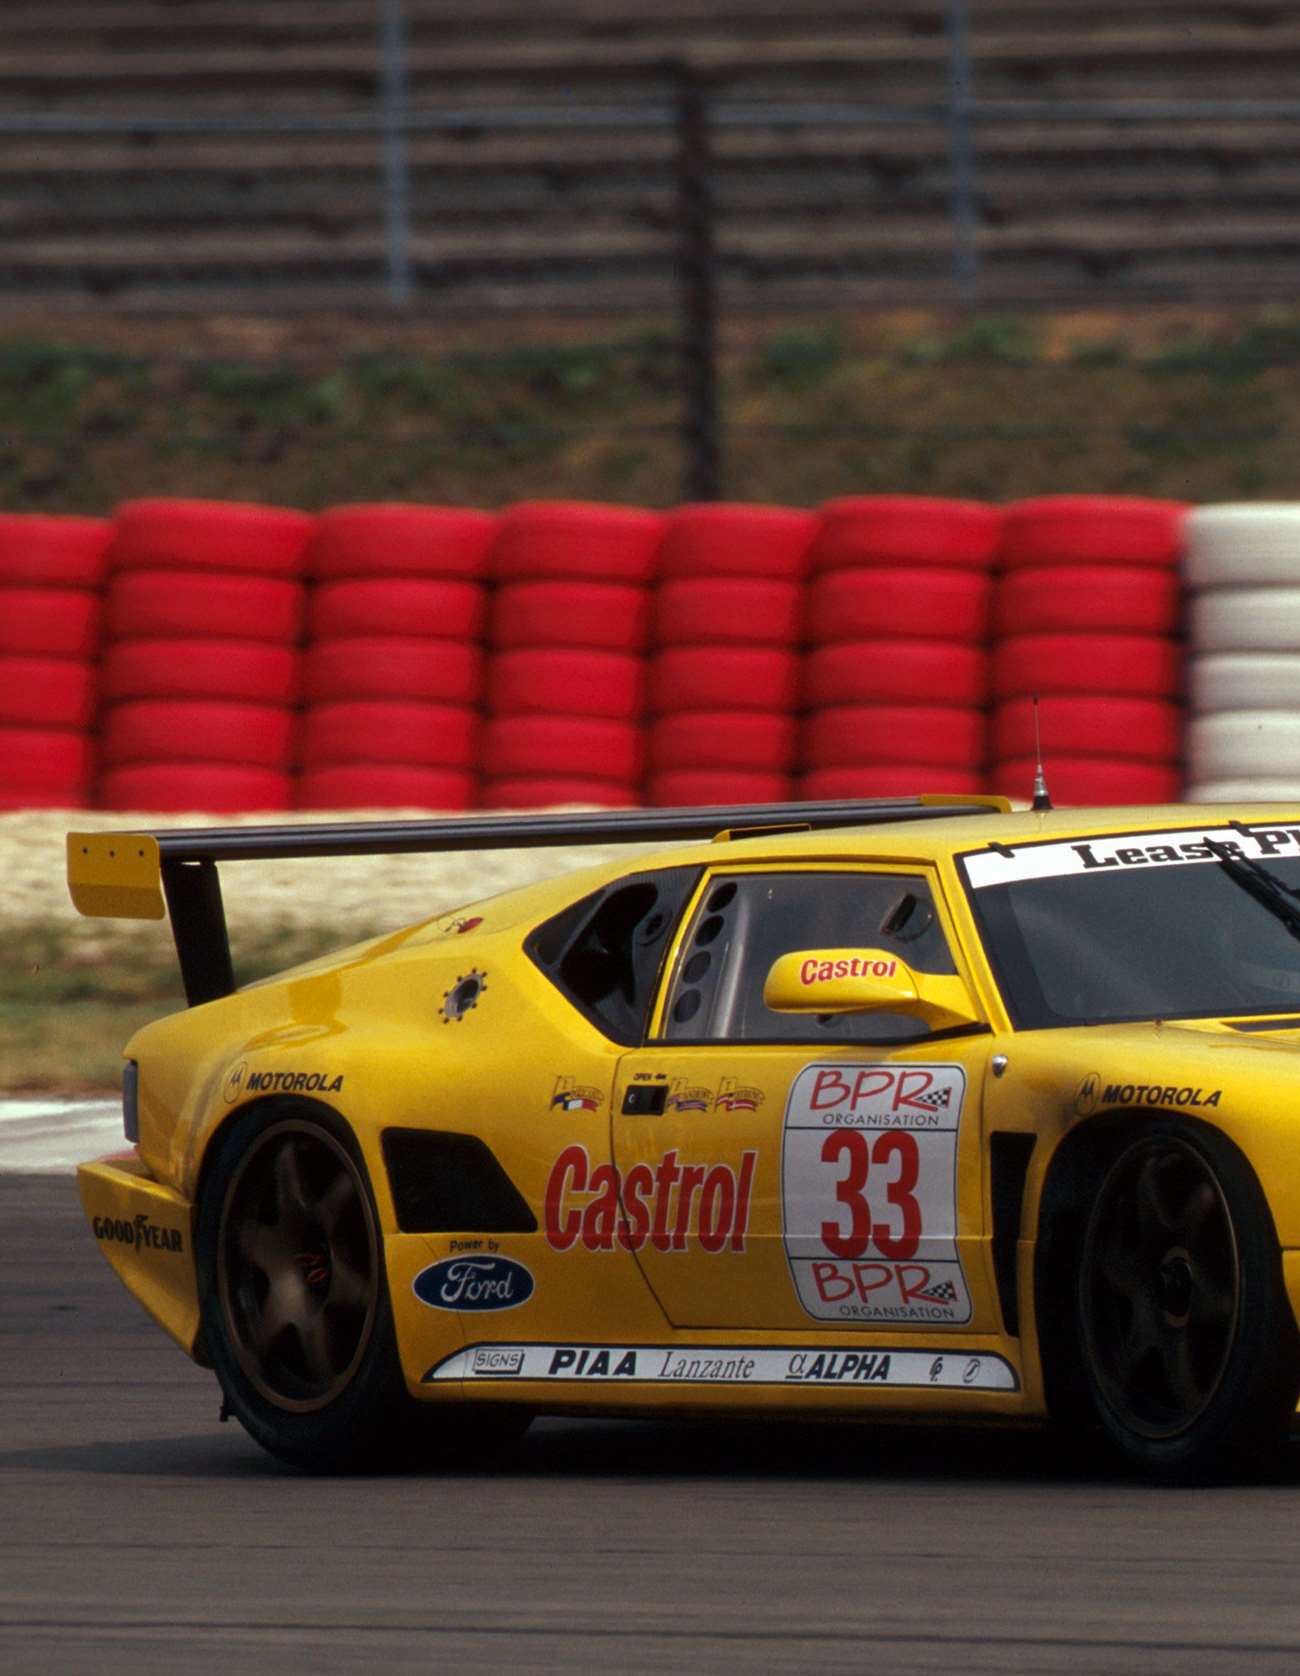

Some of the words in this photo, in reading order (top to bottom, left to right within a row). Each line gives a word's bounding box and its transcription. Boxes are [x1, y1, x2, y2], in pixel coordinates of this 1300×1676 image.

[1071, 836, 1243, 869] Lease
[800, 957, 897, 985] Castrol
[246, 1071, 345, 1093] MOTOROLA
[809, 1070, 939, 1112] BPR
[1102, 1084, 1222, 1107] MOTOROLA
[822, 1112, 939, 1127] ORGANISATION
[544, 1143, 758, 1254] Castrol
[820, 1127, 923, 1260] 33
[92, 1214, 184, 1252] GOODYEAR
[449, 1239, 484, 1253] Power
[487, 1237, 500, 1252] by
[441, 1262, 515, 1302] Ford
[811, 1263, 945, 1305] BPR
[839, 1304, 956, 1319] ORGANISATION
[475, 1352, 520, 1368] SIGNS
[548, 1350, 638, 1376] PIAA
[657, 1351, 756, 1379] Lanzante
